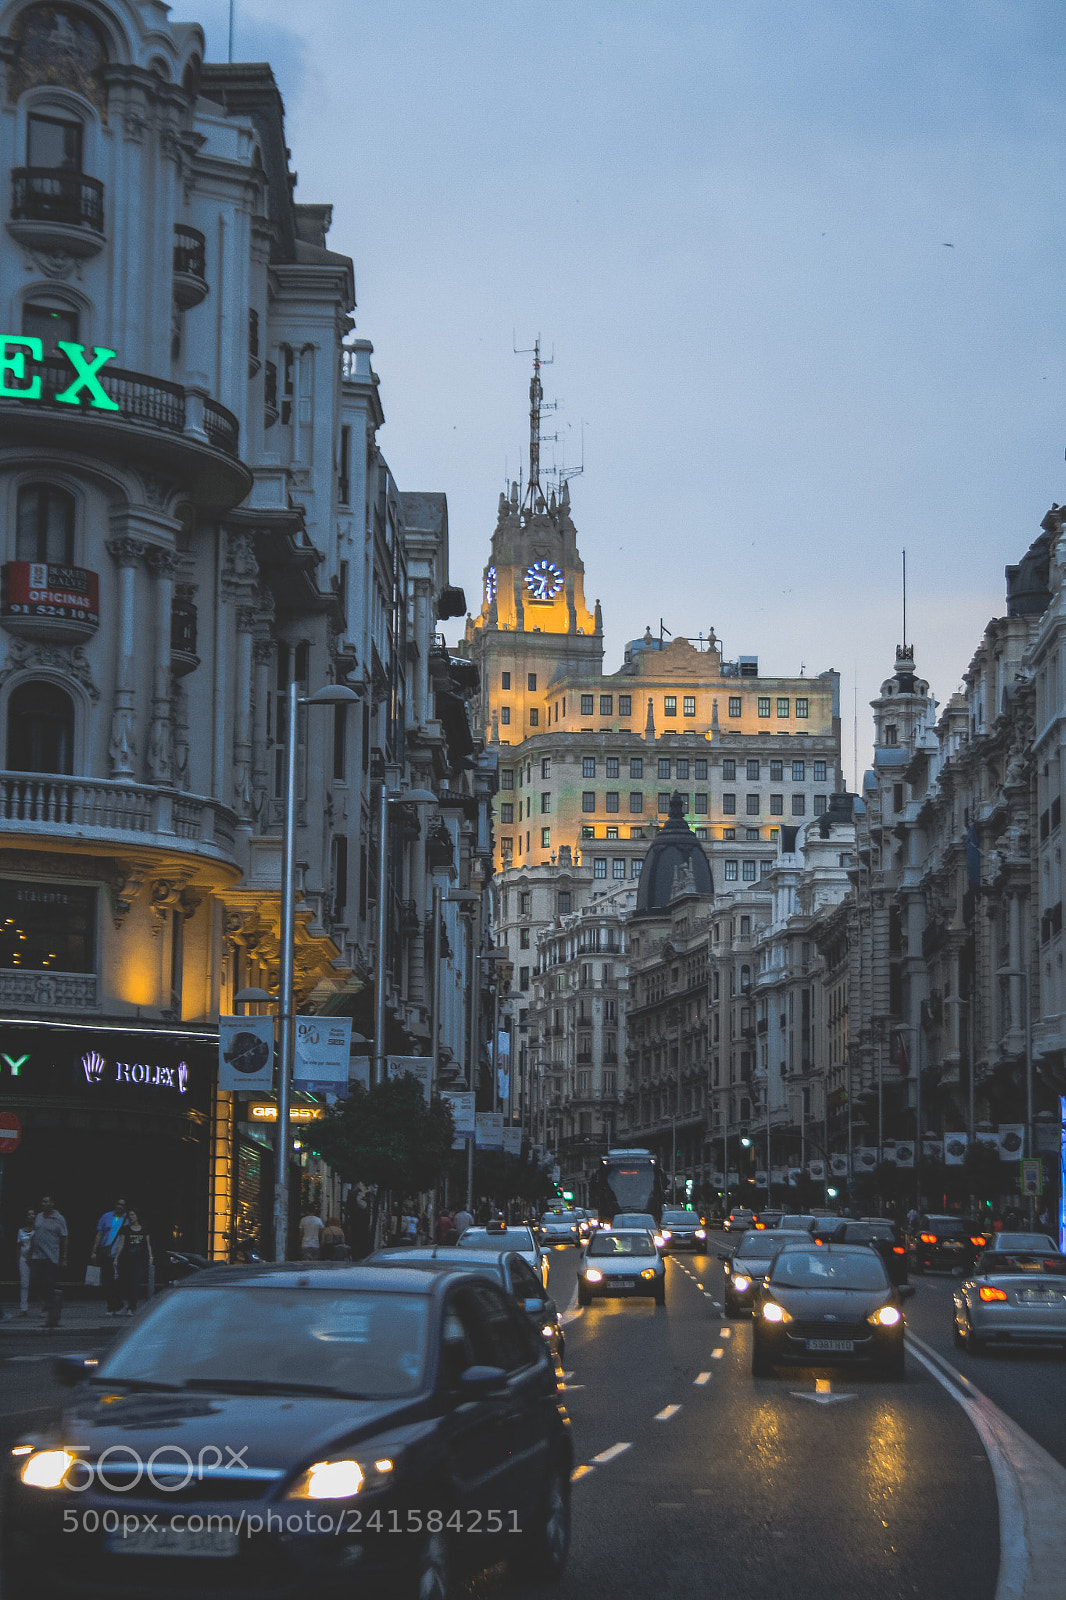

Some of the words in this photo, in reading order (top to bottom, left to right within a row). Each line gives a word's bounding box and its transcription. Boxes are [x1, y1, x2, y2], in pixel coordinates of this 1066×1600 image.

[29, 591, 90, 607] OFICINAS
[10, 604, 29, 614] 91
[36, 605, 65, 616] 524
[71, 609, 86, 619] 10
[116, 1061, 175, 1088] ROLEX
[252, 1107, 321, 1118] GRSSY
